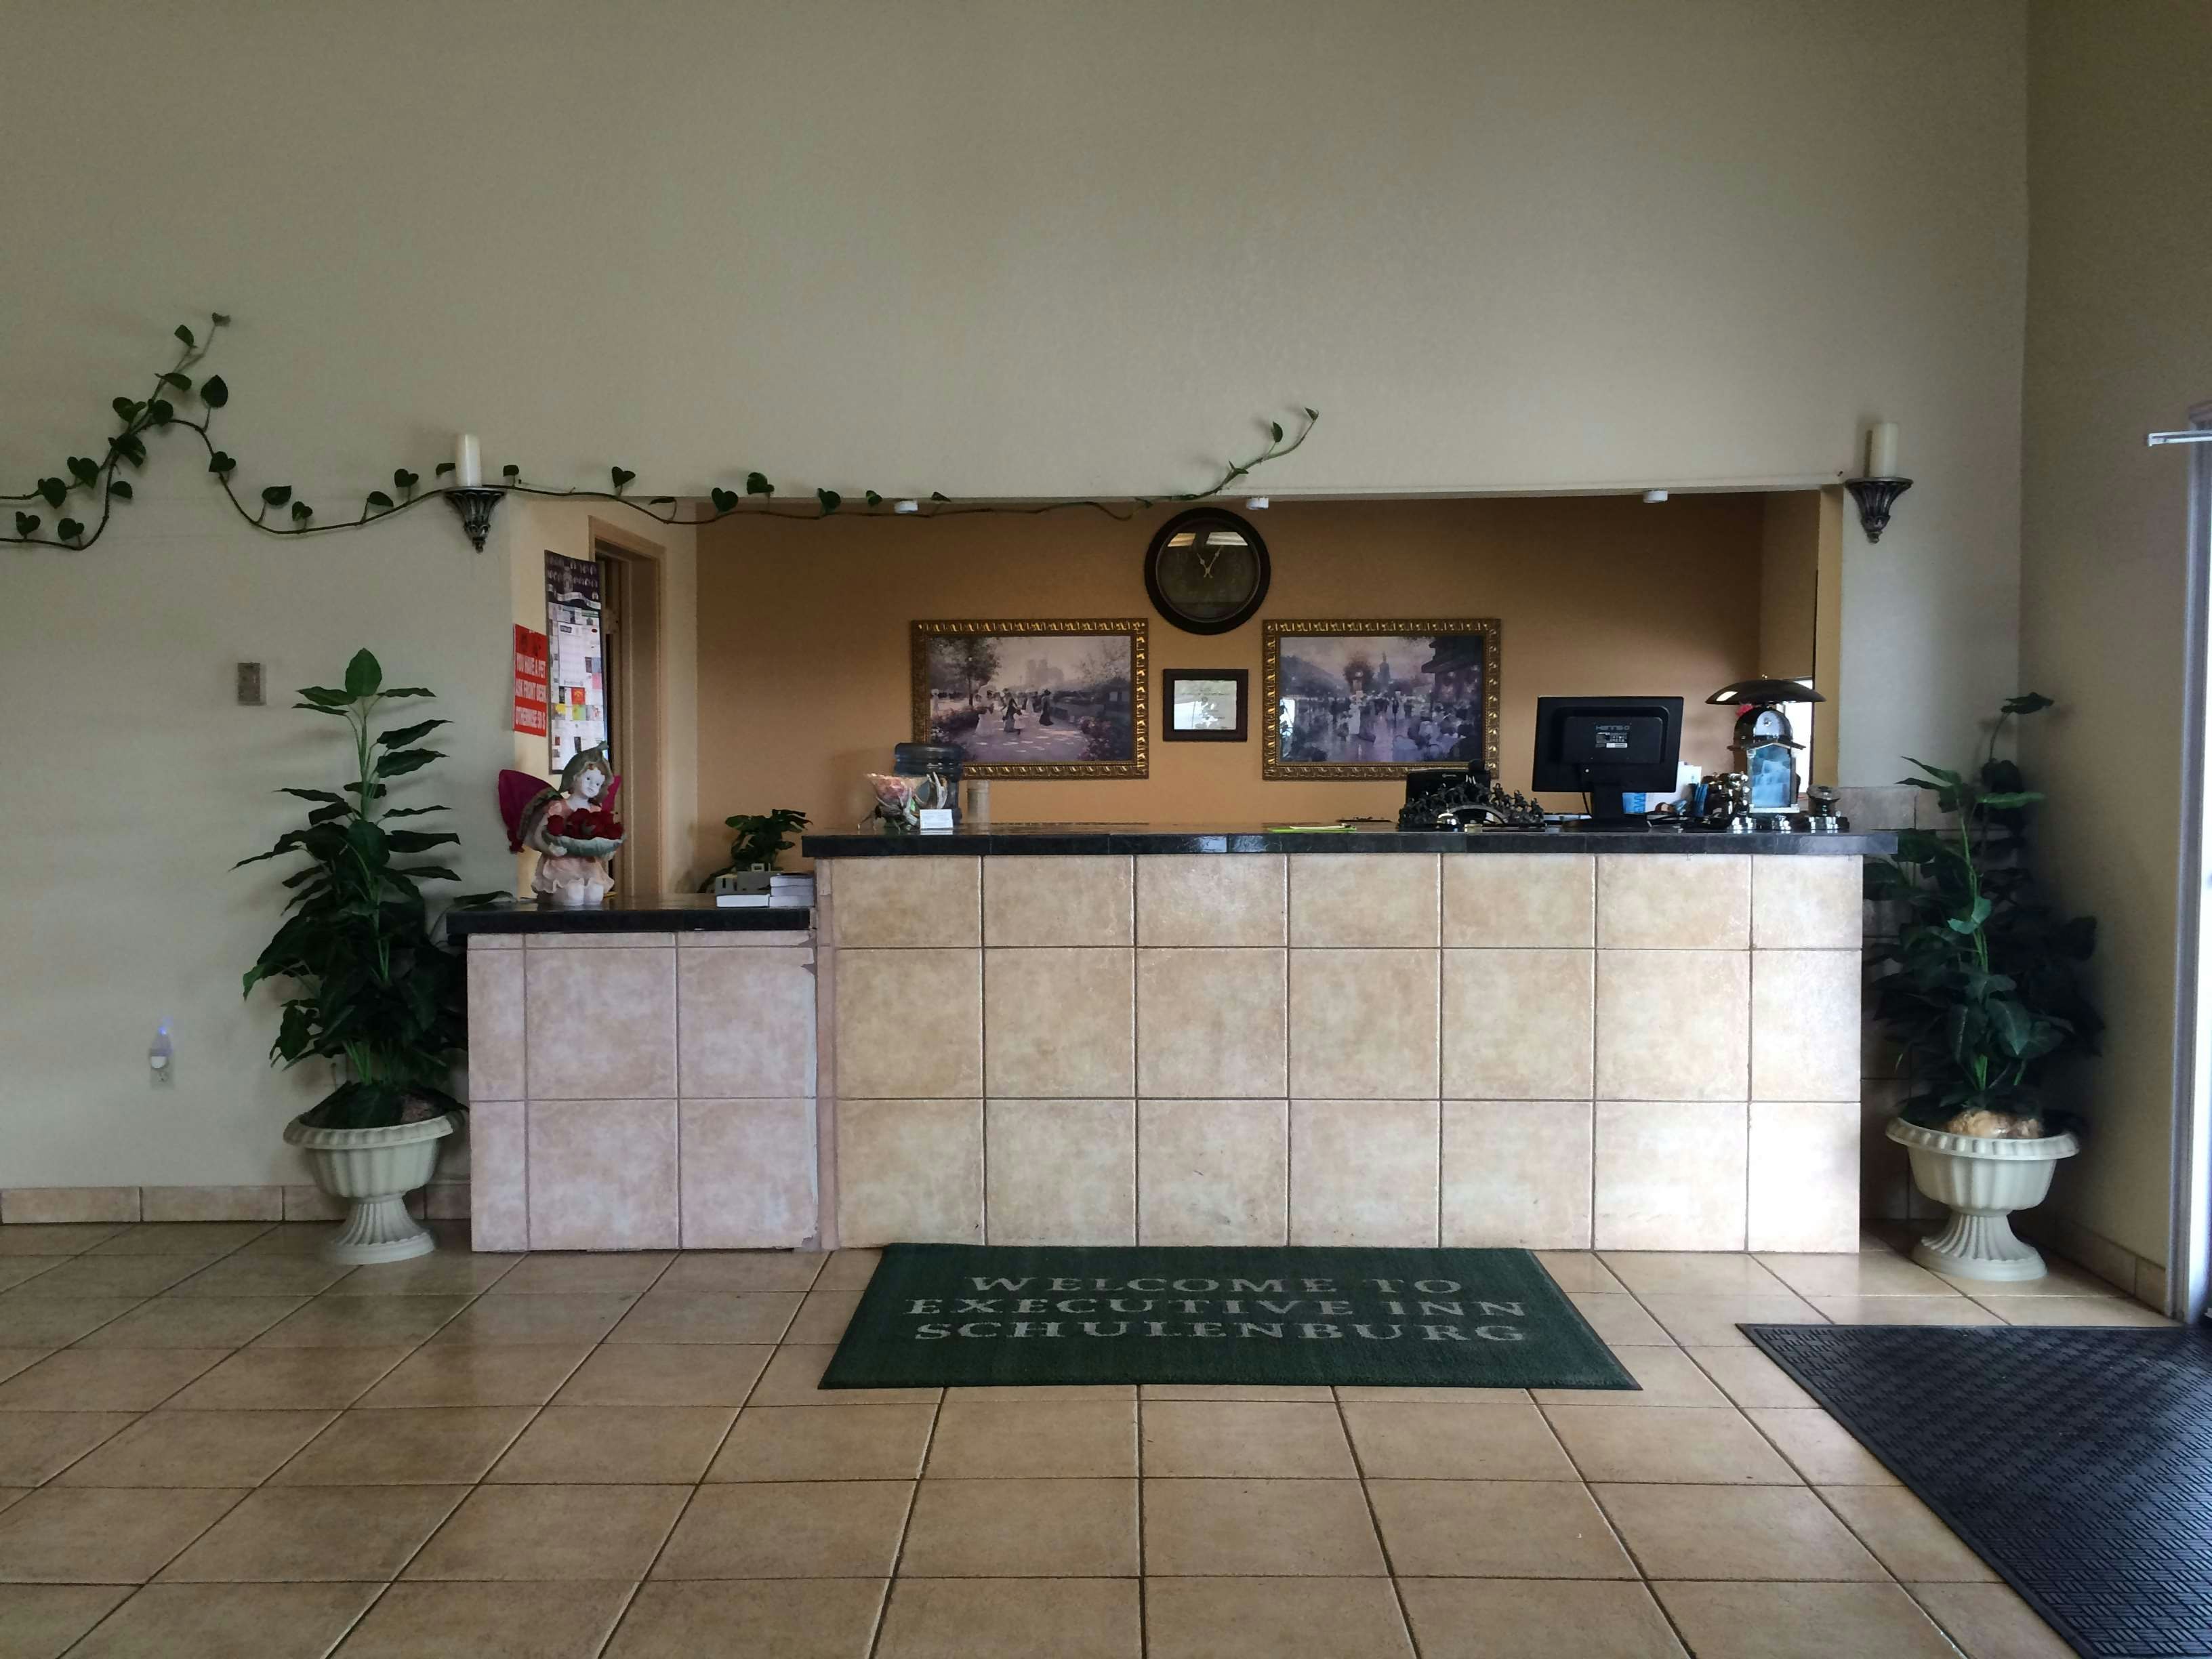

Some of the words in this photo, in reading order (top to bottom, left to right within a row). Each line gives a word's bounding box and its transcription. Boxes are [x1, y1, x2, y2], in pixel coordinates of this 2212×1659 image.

[966, 1277, 1337, 1292] WELCOME
[1364, 1279, 1461, 1294] TO
[903, 1298, 1353, 1315] EXECUTIVE
[1382, 1301, 1525, 1316] INN
[914, 1321, 1525, 1341] SCHULENBURG
